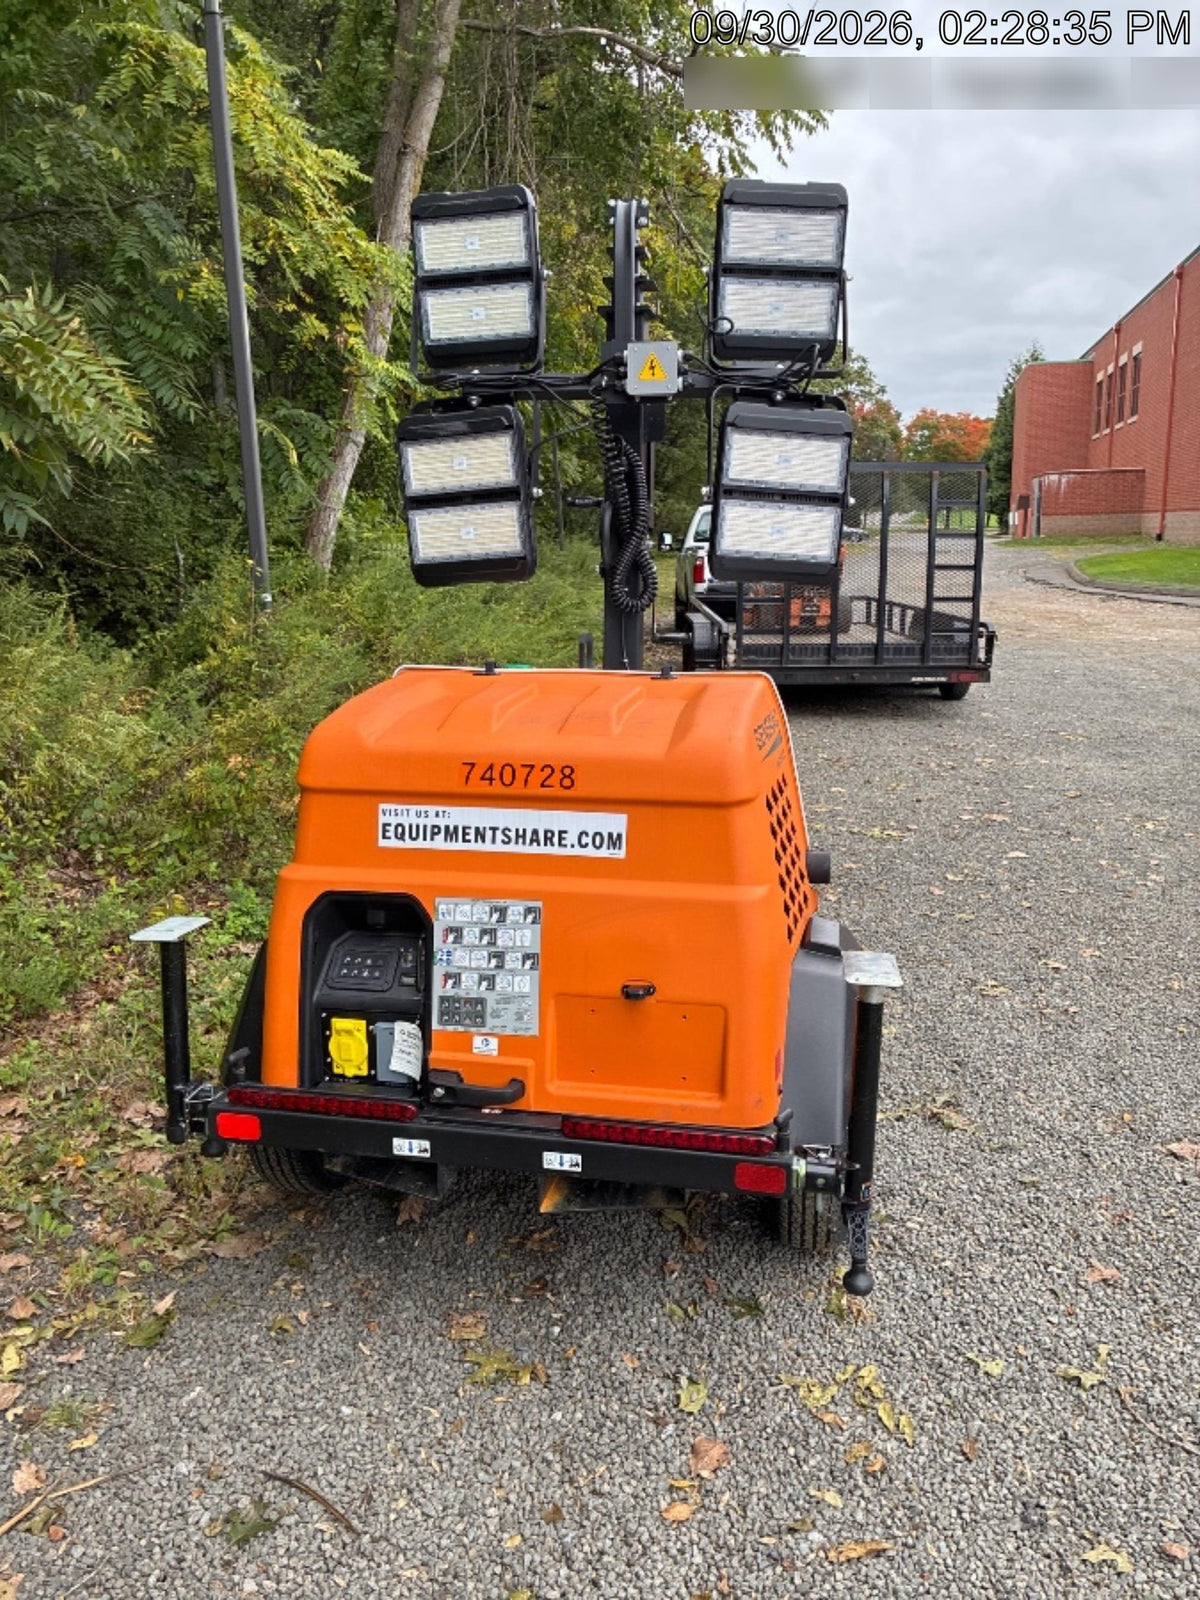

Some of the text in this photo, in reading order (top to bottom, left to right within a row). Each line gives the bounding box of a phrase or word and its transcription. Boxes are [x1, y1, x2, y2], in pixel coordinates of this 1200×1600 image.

[462, 762, 576, 790] 740728
[382, 808, 451, 819] VISIT US AT:
[381, 822, 623, 851] EQUIPMENTSHARE.COM
